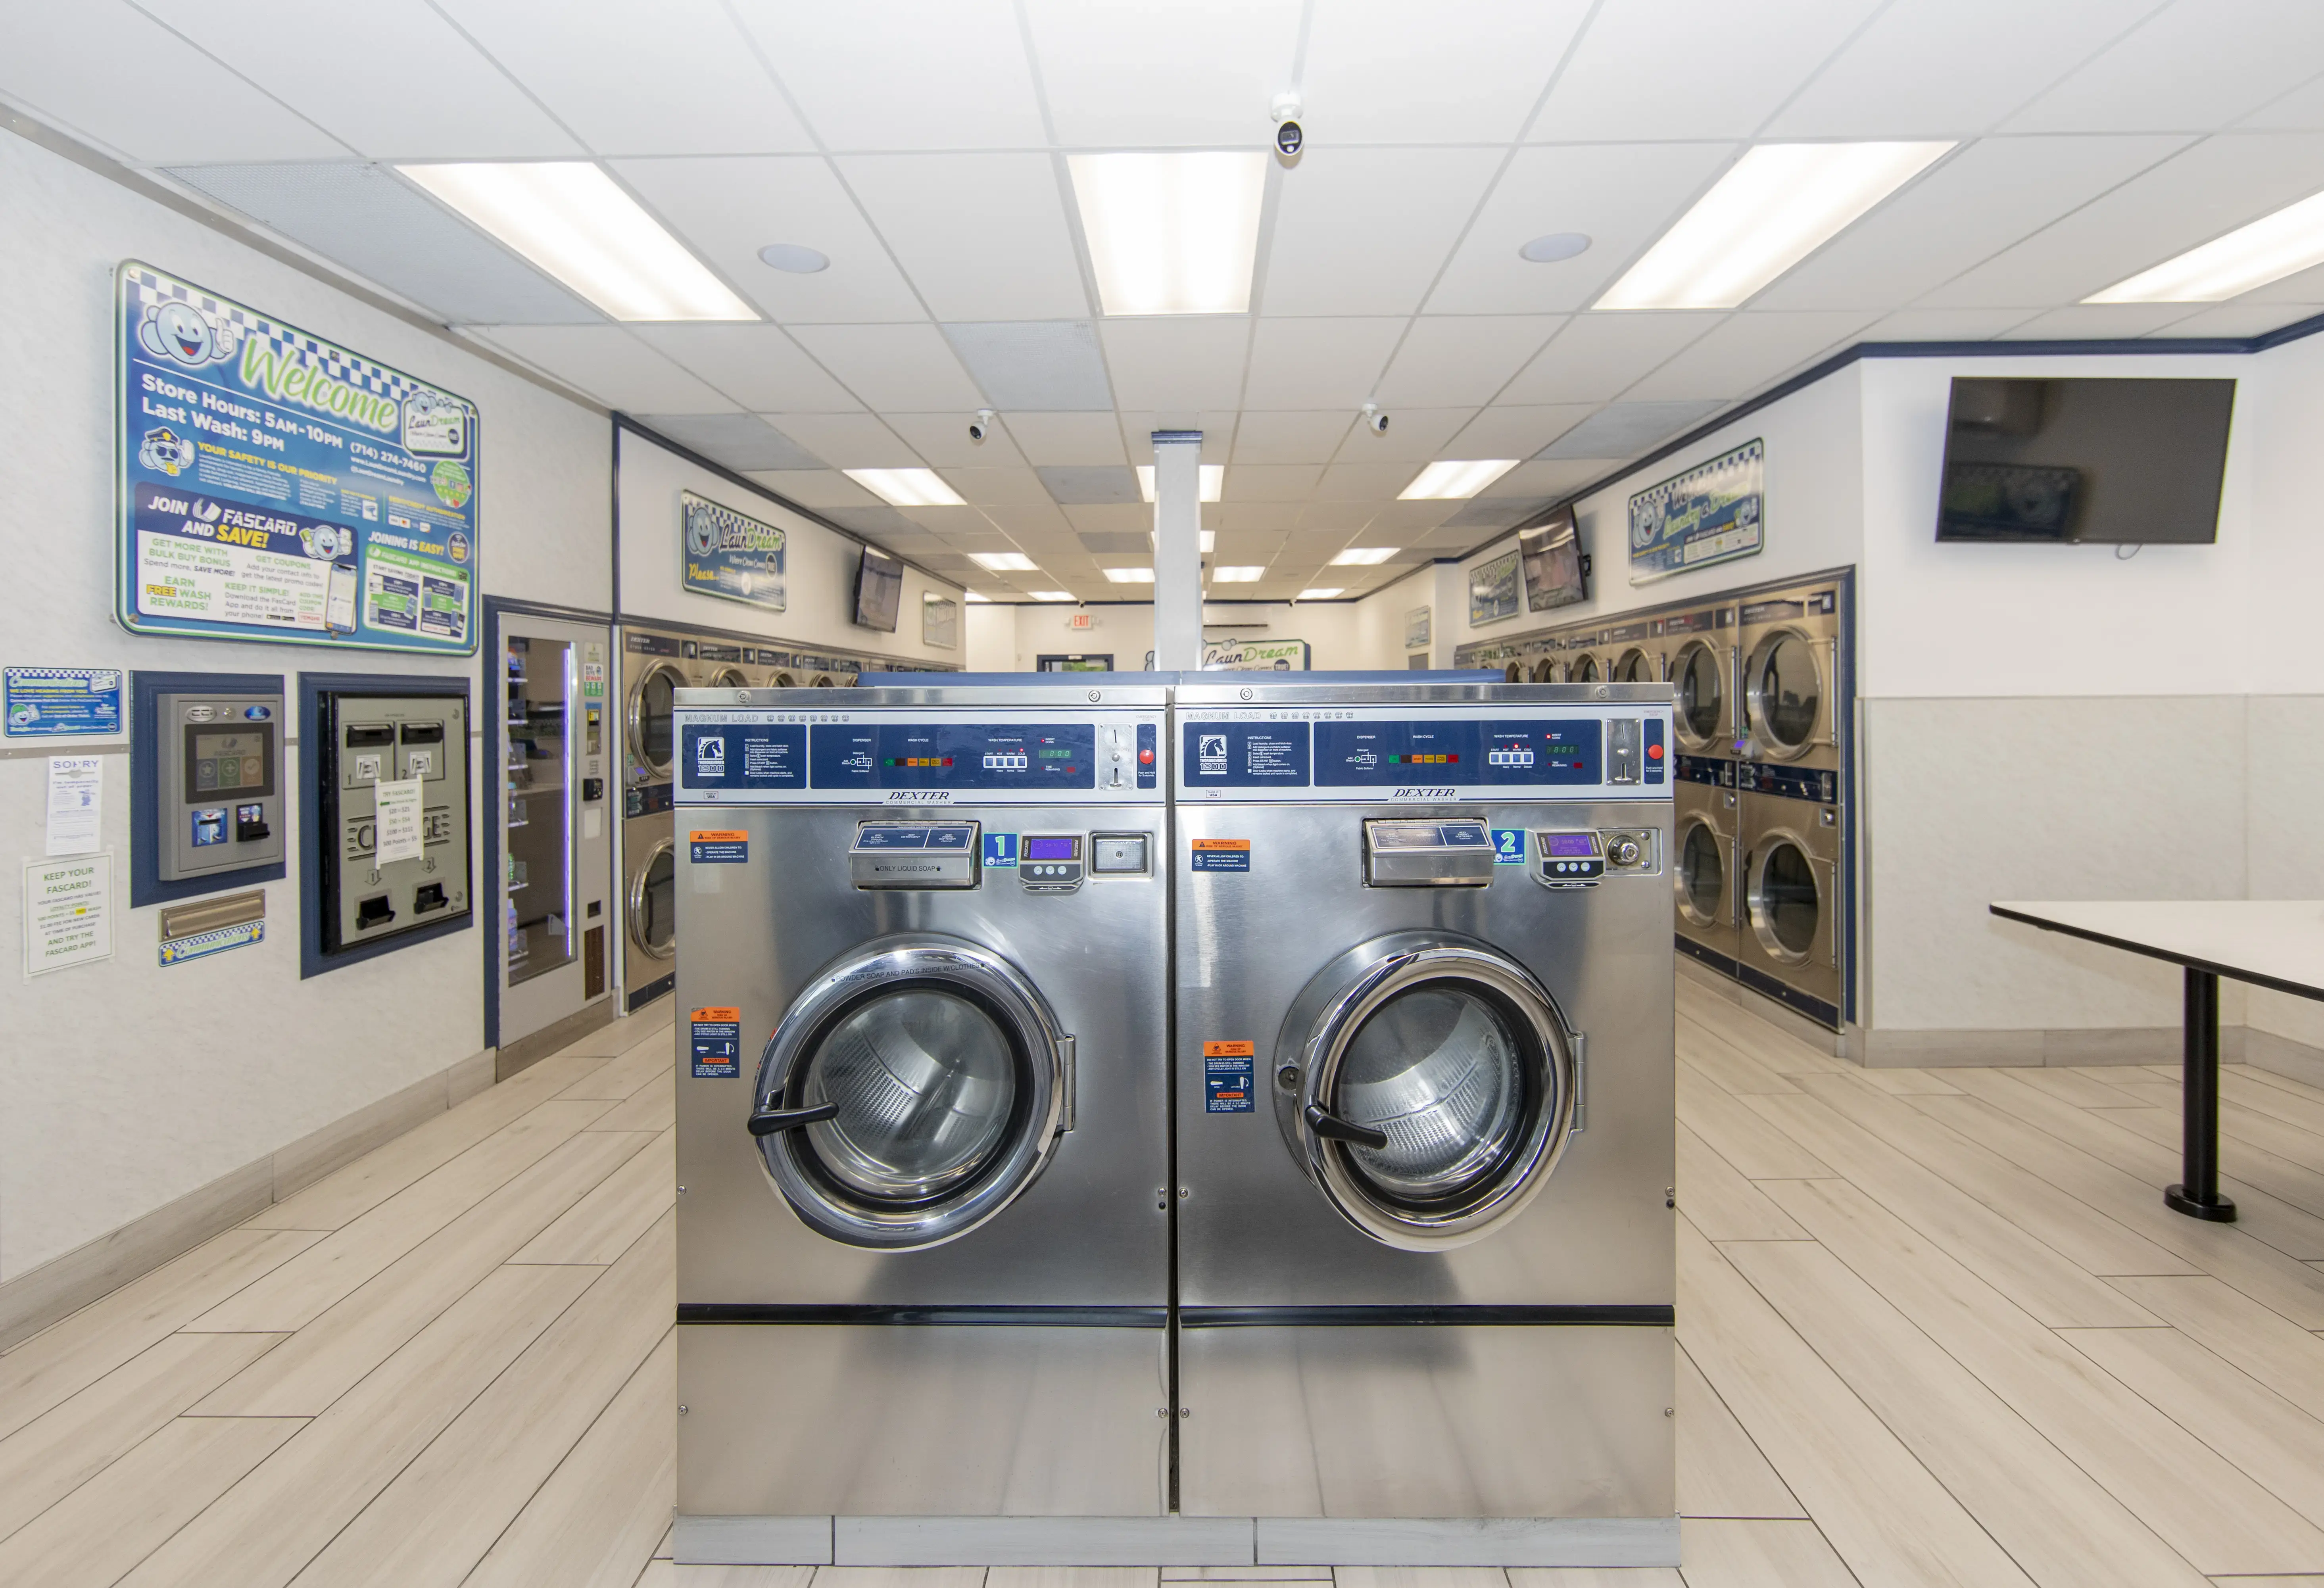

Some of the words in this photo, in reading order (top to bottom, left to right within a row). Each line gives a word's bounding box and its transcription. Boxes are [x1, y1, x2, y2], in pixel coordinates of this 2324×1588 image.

[242, 336, 397, 431] Welcome
[142, 373, 197, 403] Store
[202, 392, 261, 424] Hours:
[142, 396, 187, 424] Last
[191, 410, 248, 441] Wash:
[252, 430, 284, 451] 9PM
[198, 442, 227, 457] YOUR
[228, 450, 266, 467] SAFETY
[267, 460, 277, 470] IS
[278, 463, 297, 475] OUR
[298, 468, 338, 485] PRIORITY
[350, 442, 378, 459] (714)
[380, 451, 426, 473] 274-7460
[148, 495, 189, 516] JOIN
[222, 508, 297, 536] FASCARD
[181, 520, 215, 537] AND
[216, 524, 270, 549] SAVE!
[368, 531, 408, 549] JOINING
[409, 538, 419, 551] IS
[419, 541, 445, 555] EASY!
[719, 523, 781, 550] LaunDream
[152, 538, 171, 547] GET
[174, 541, 202, 553] MORE
[204, 546, 229, 557] WITH
[144, 558, 168, 568] Spend
[171, 563, 191, 572] more,
[194, 565, 212, 574] SAVE
[149, 548, 175, 559] BULK
[177, 552, 197, 562] BUY
[200, 556, 231, 567] BONUS
[255, 555, 272, 564] GET
[274, 557, 311, 570] COUPONS
[165, 576, 195, 588] EARN
[225, 581, 247, 591] KEEP
[258, 586, 290, 597] SIMPLE!
[146, 584, 177, 597] FREE
[179, 588, 212, 601] WASH
[150, 596, 209, 611] REWARDS!
[1074, 615, 1089, 626] EXIT
[1204, 645, 1298, 667] LaunDream
[684, 714, 728, 722] MAGNUM
[1186, 712, 1229, 720] MAGNUM
[53, 760, 99, 769] SORY
[402, 769, 408, 780] 2
[1393, 789, 1456, 797] DEXTER
[357, 815, 442, 851] CGE
[1500, 831, 1515, 853] 2
[995, 835, 1005, 856] 1
[43, 871, 66, 881] KEEP
[68, 867, 95, 877] YOUR
[46, 880, 92, 894] FASCARD!
[48, 937, 64, 946] AND
[65, 934, 79, 943] TRY
[81, 931, 94, 939] THE
[45, 944, 79, 957] FASCARD
[80, 940, 96, 949] APP!
[836, 973, 865, 982] POWDER
[943, 962, 980, 972] W/CLOTHES
